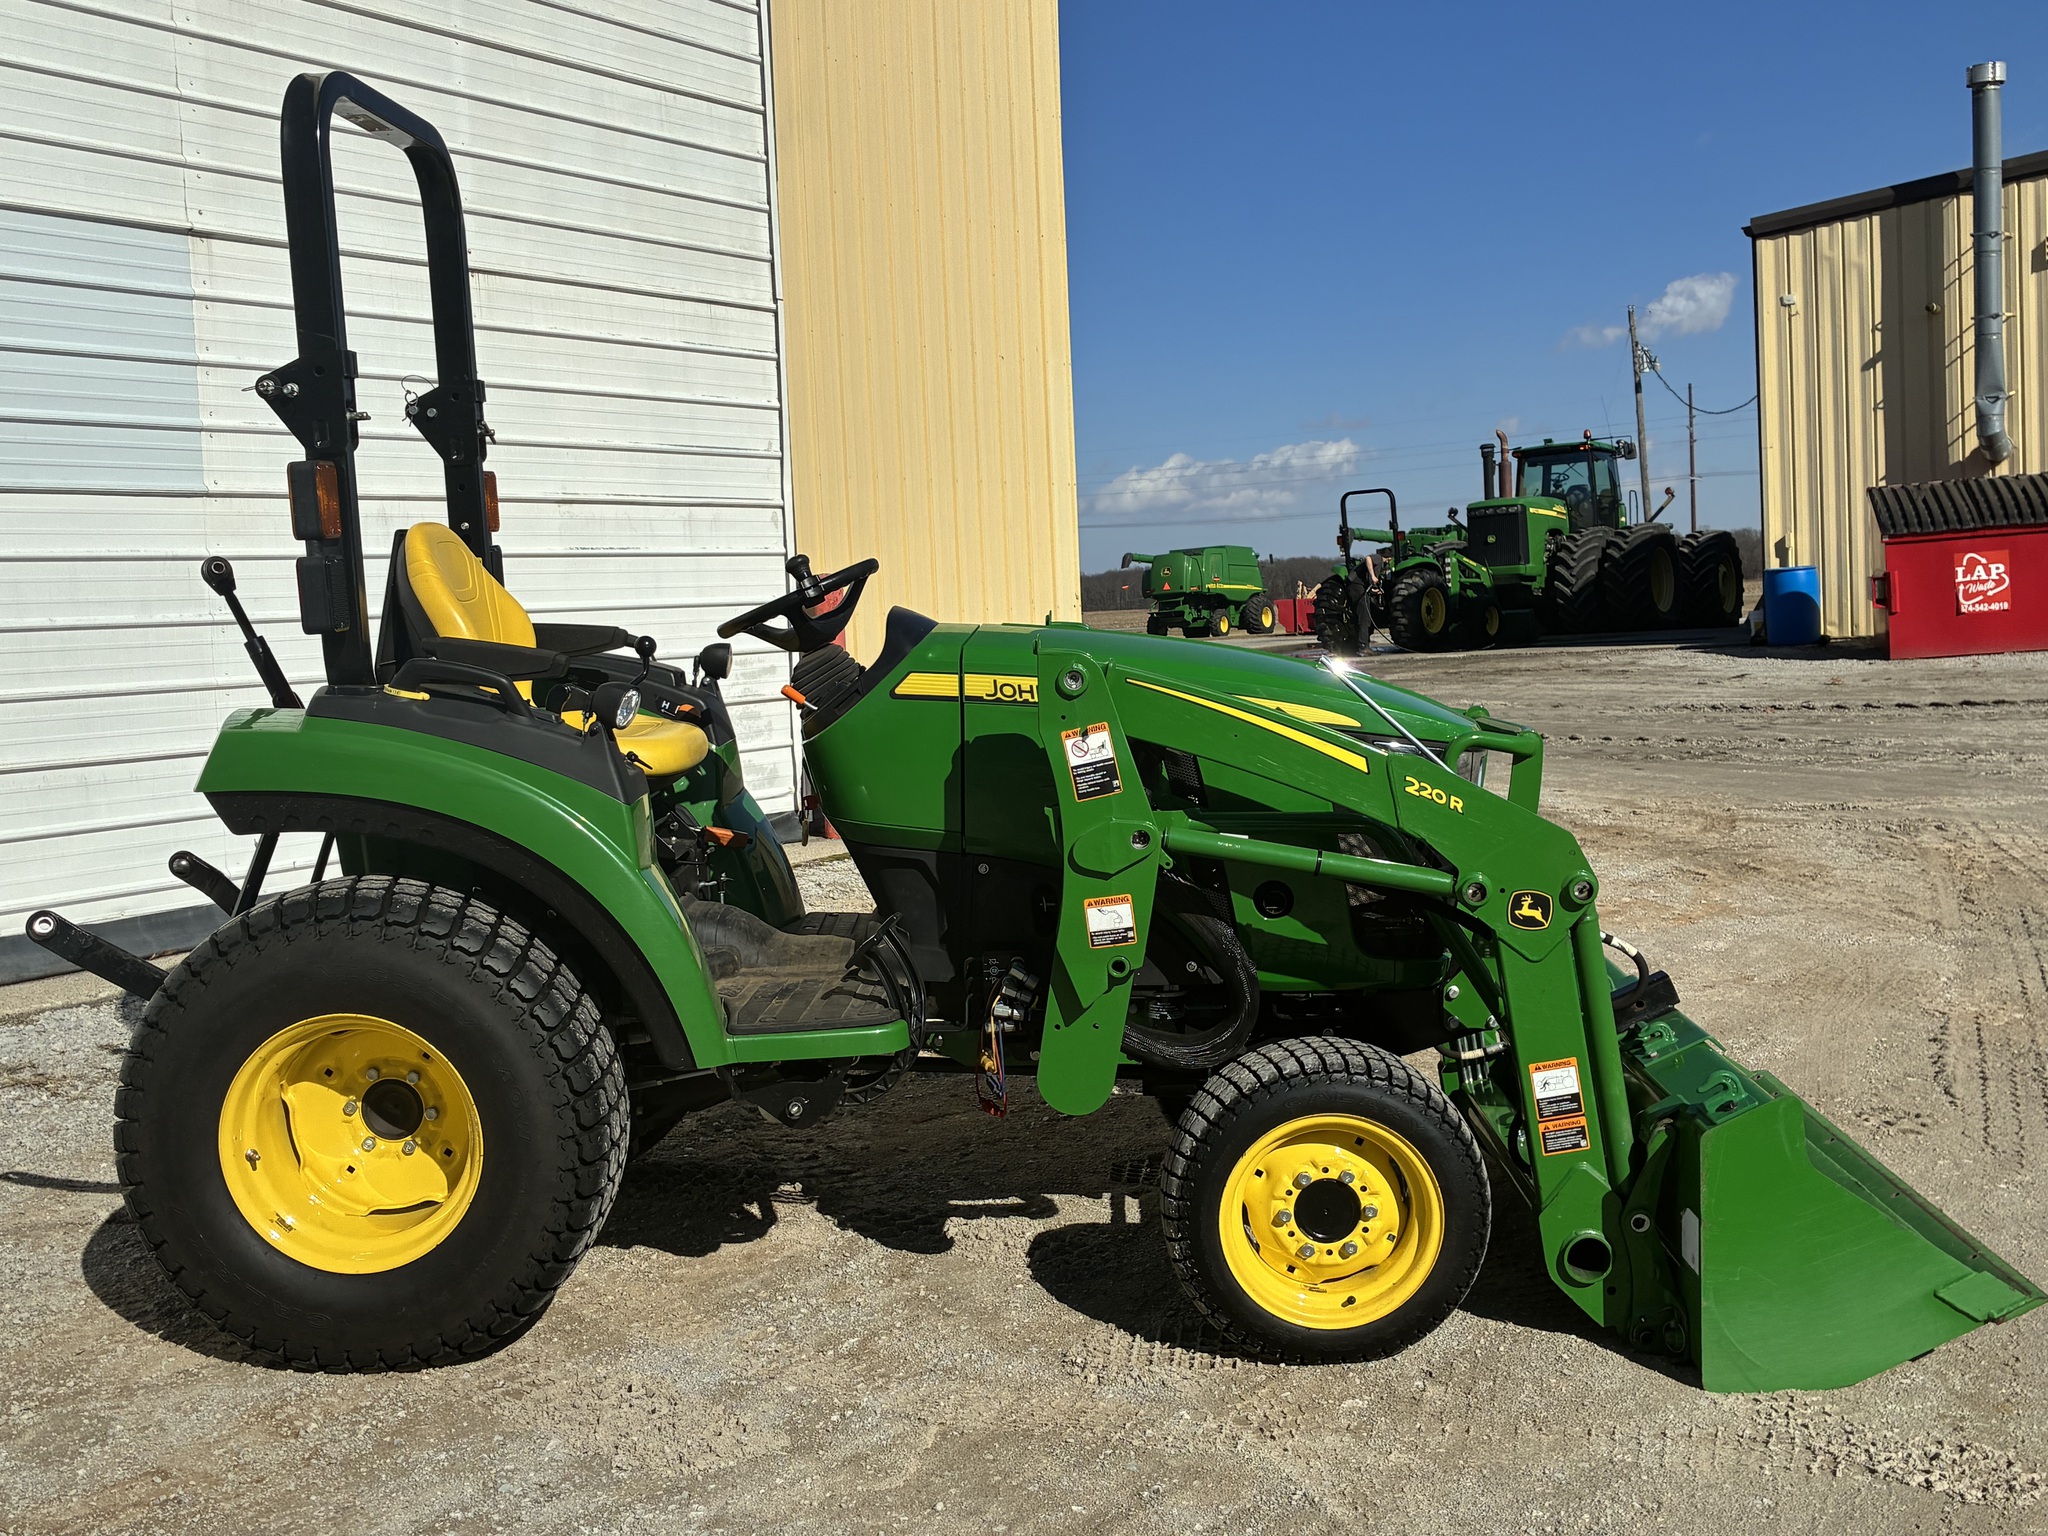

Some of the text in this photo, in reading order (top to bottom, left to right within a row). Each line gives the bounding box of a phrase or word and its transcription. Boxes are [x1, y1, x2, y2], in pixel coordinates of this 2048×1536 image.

[1955, 563, 2005, 582] LAP
[1965, 580, 1996, 594] Waste
[985, 679, 1038, 700] JOH
[1071, 723, 1107, 737] WNING
[1093, 895, 1130, 906] WARNING
[1541, 1059, 1572, 1070] WARNING
[1551, 1120, 1582, 1130] WARNING
